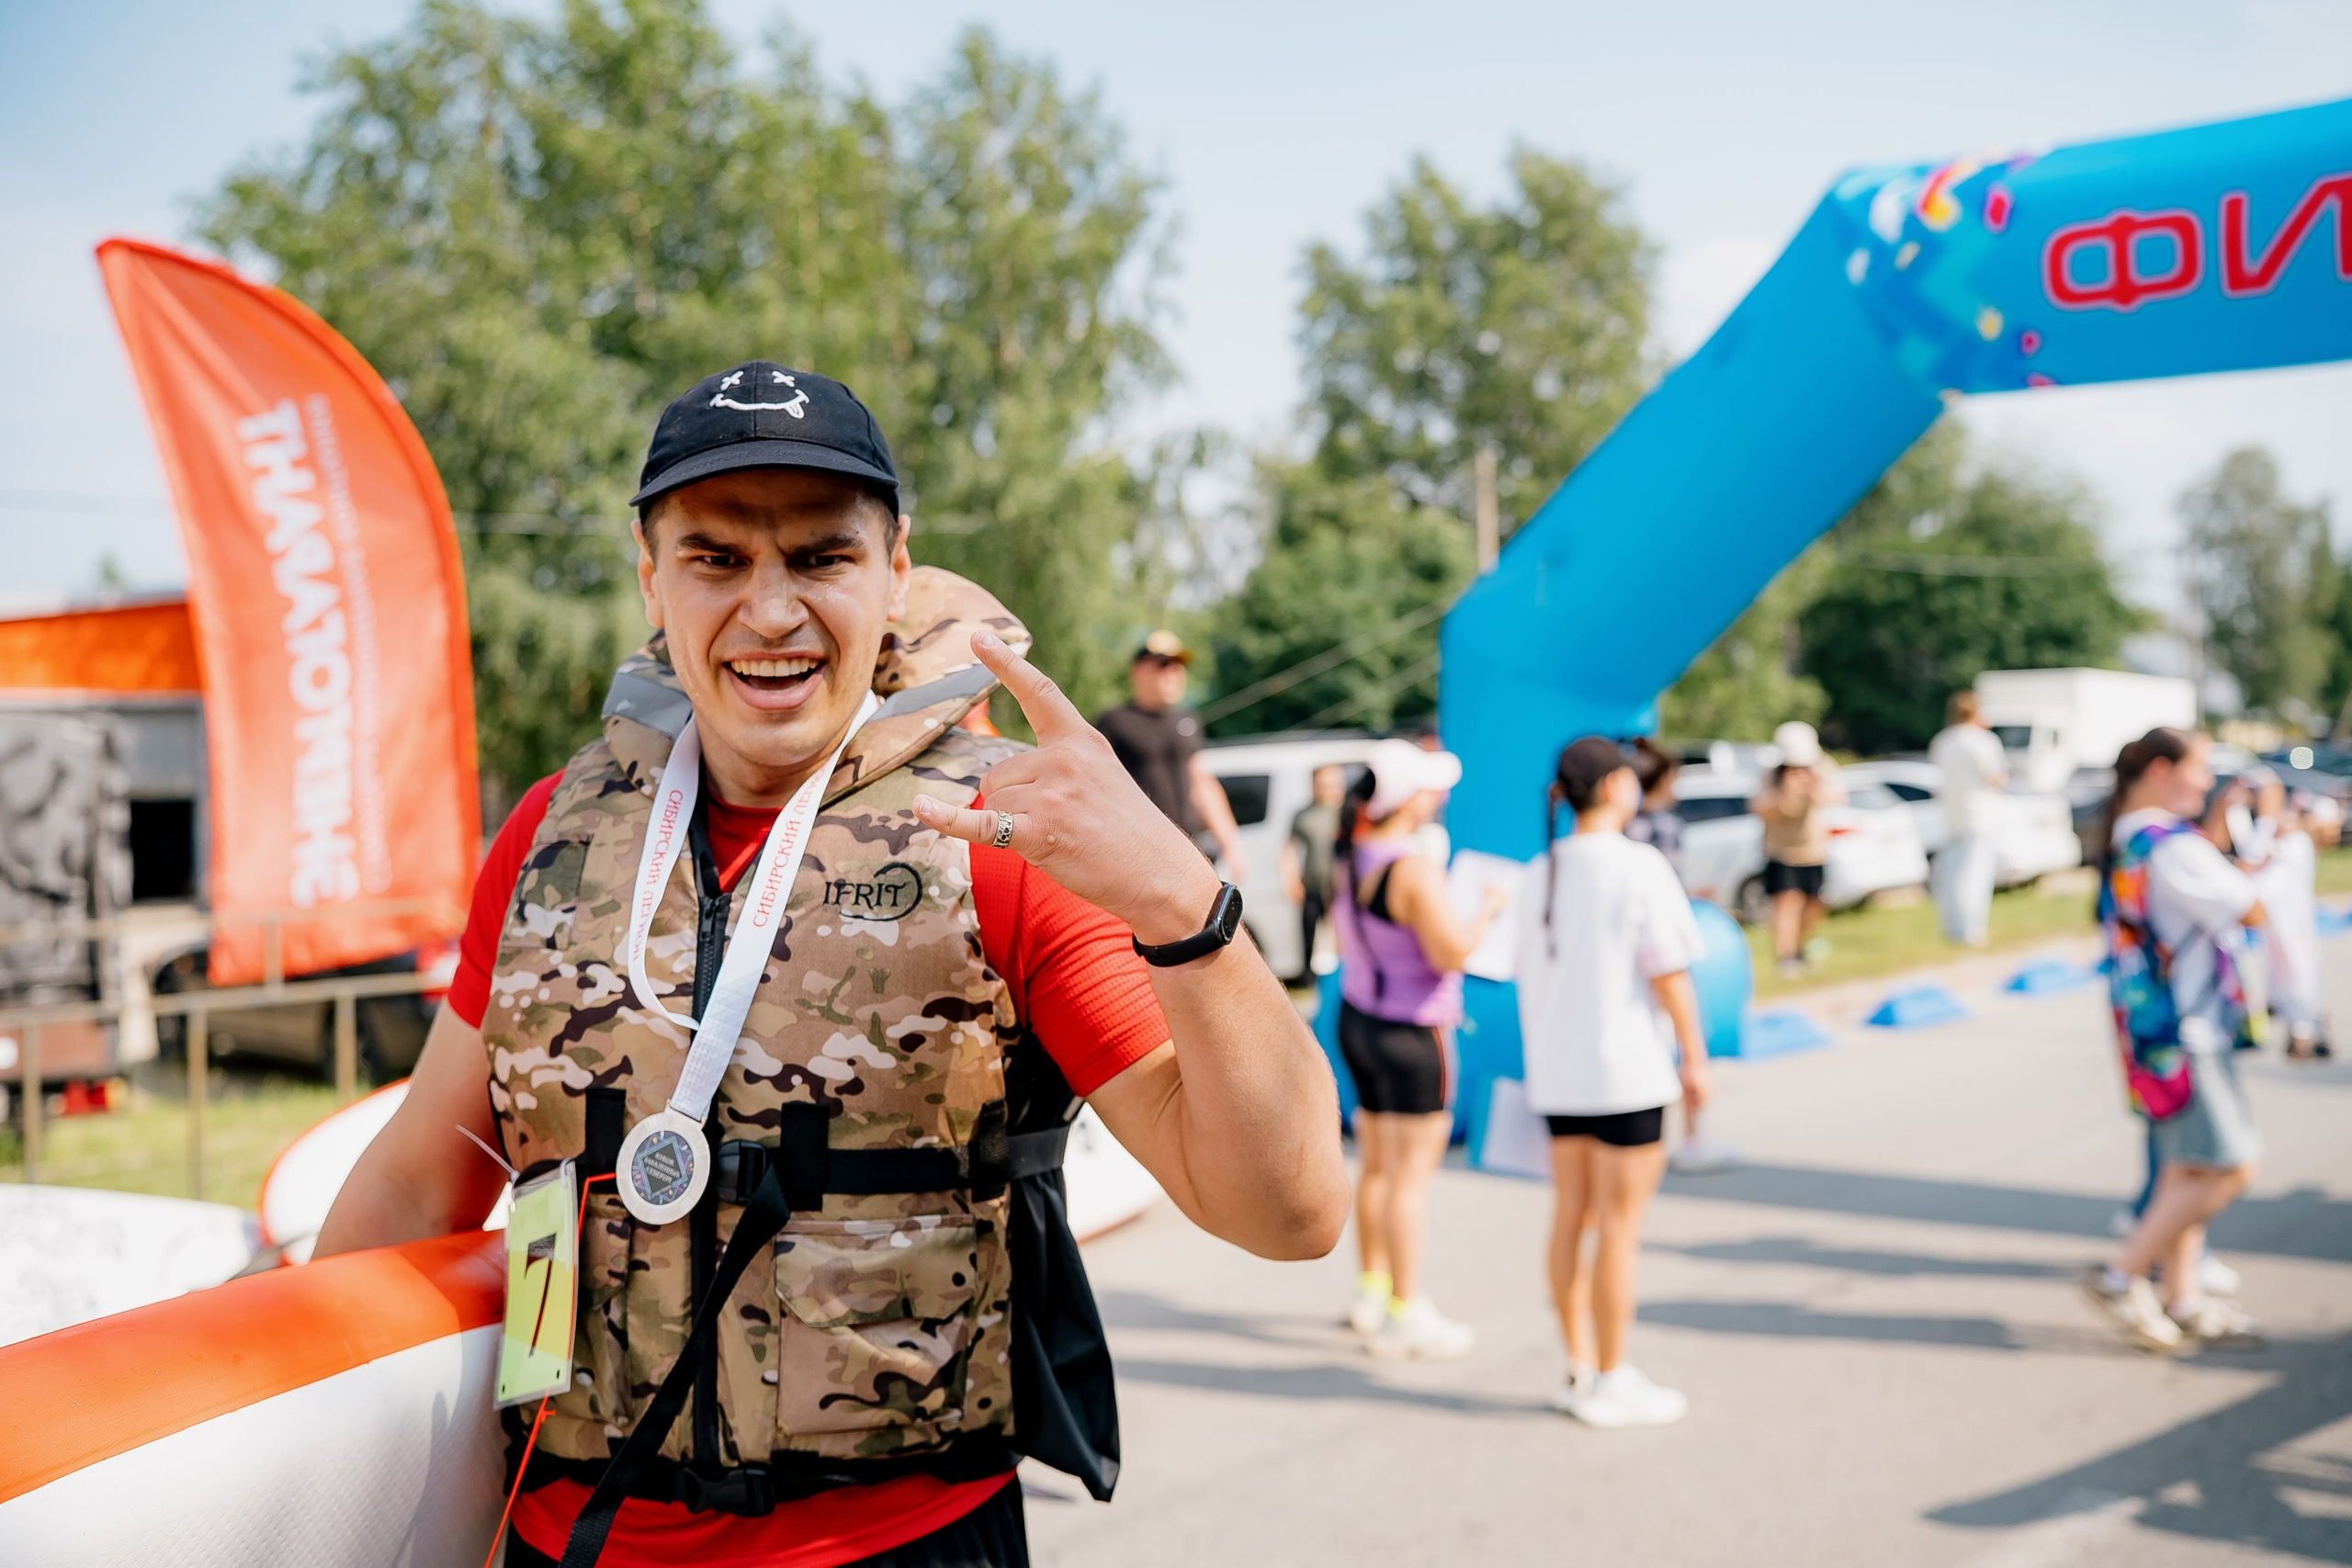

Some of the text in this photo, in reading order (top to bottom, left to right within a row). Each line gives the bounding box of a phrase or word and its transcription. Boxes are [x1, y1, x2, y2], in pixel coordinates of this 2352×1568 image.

[2042, 171, 2352, 313] ФИ
[647, 789, 684, 885] СИБИРСКИЙ
[752, 819, 801, 928] СИБИРСКИЙ
[822, 881, 908, 910] IFRIT
[524, 1233, 557, 1357] 7
